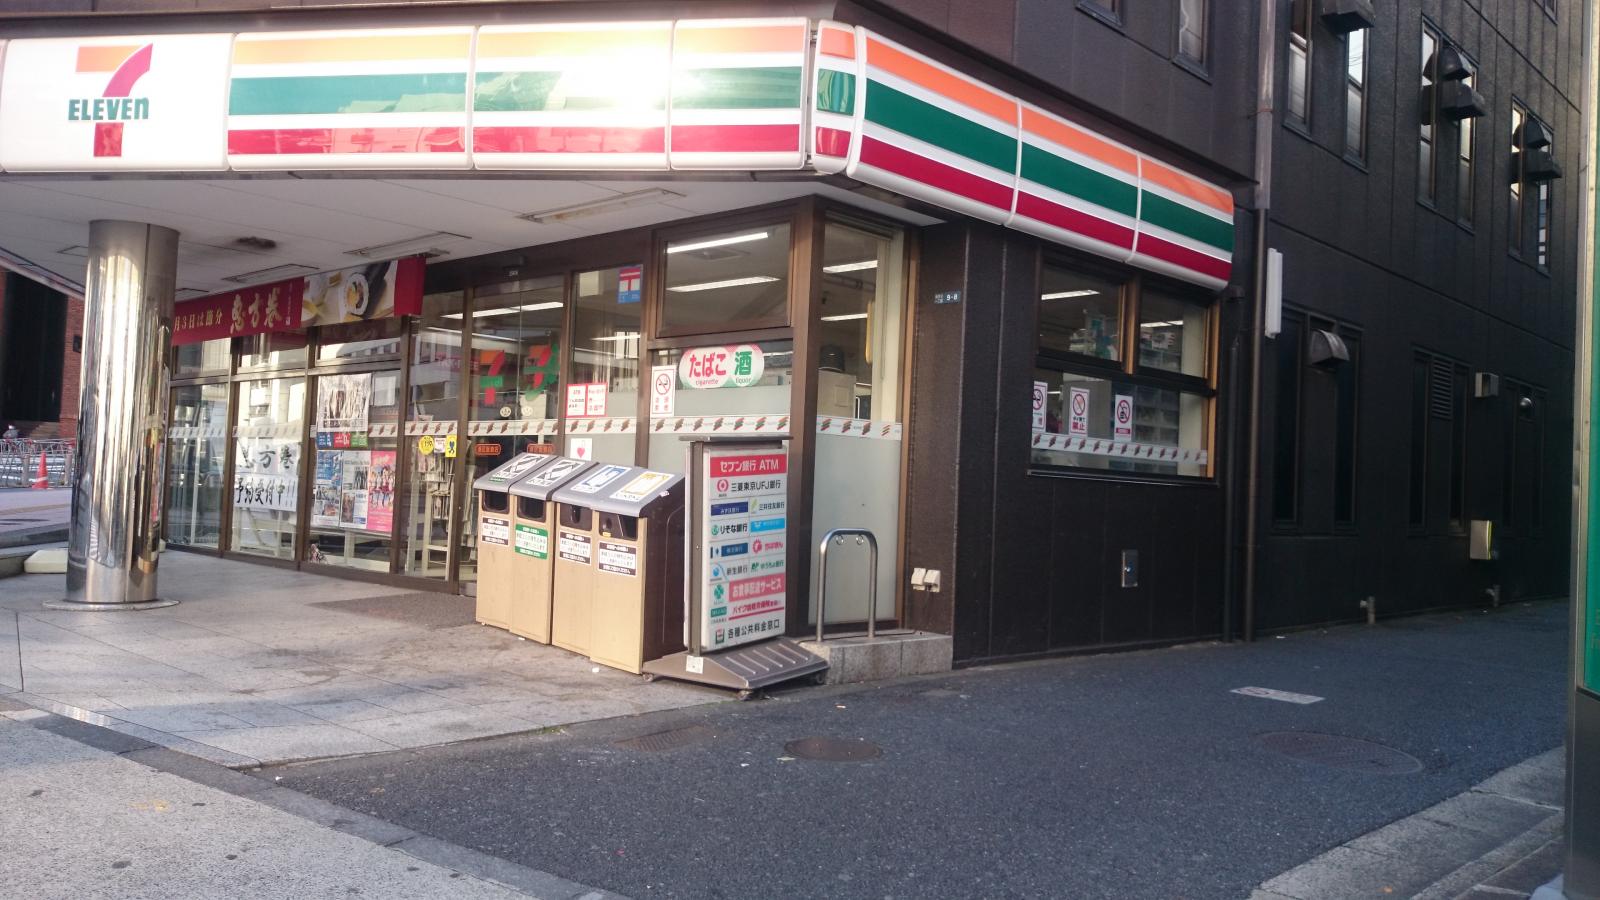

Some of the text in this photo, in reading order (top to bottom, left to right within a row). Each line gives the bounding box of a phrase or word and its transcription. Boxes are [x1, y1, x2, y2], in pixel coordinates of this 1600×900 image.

[689, 350, 752, 378] たばこ 酒
[720, 458, 779, 473] セブン銀行 ATM
[731, 479, 781, 492] 三菱東京UFJ銀行
[759, 501, 785, 511] 三井住友銀行
[720, 523, 748, 534] りそな銀行
[728, 619, 780, 639] 各種公共料金窓口
